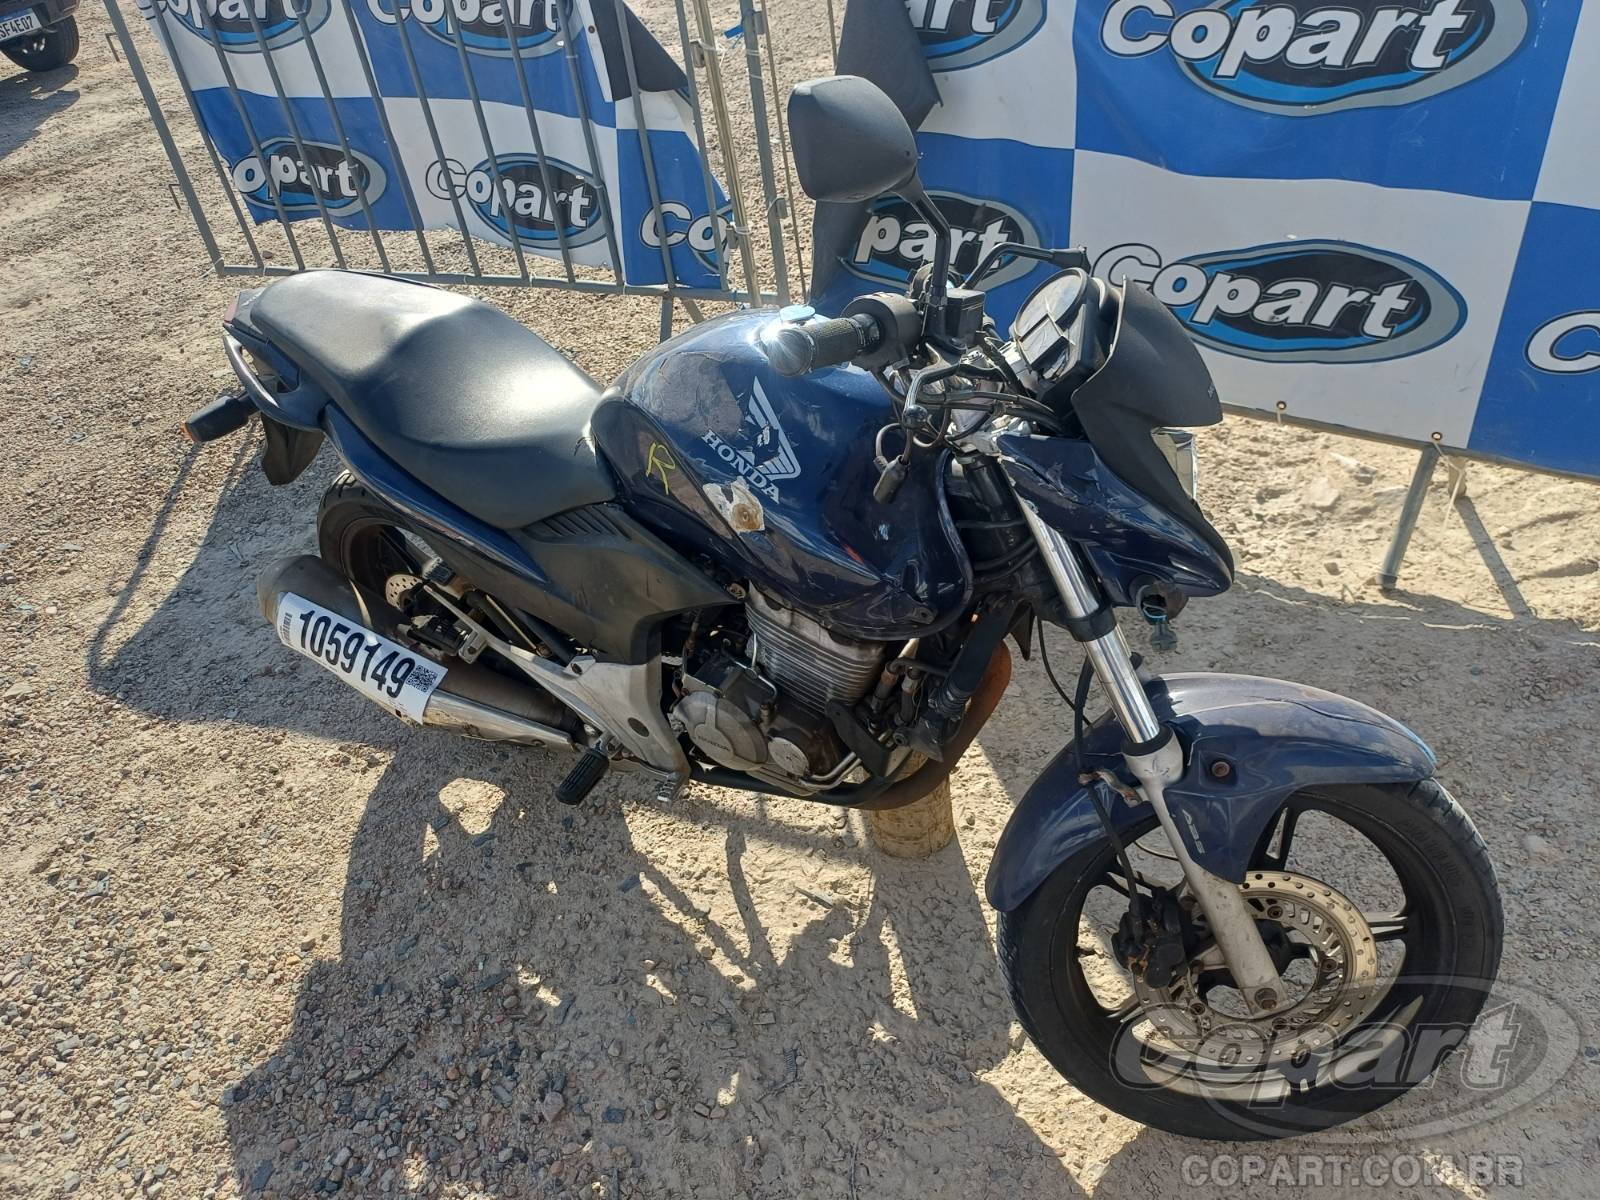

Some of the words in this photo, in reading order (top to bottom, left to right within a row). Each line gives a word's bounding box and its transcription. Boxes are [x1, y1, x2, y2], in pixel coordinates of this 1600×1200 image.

[1101, 0, 1470, 79] Copart
[232, 153, 359, 199] opart
[1092, 243, 1422, 341] Copart
[701, 429, 781, 504] HONDA
[299, 609, 416, 699] 1059149
